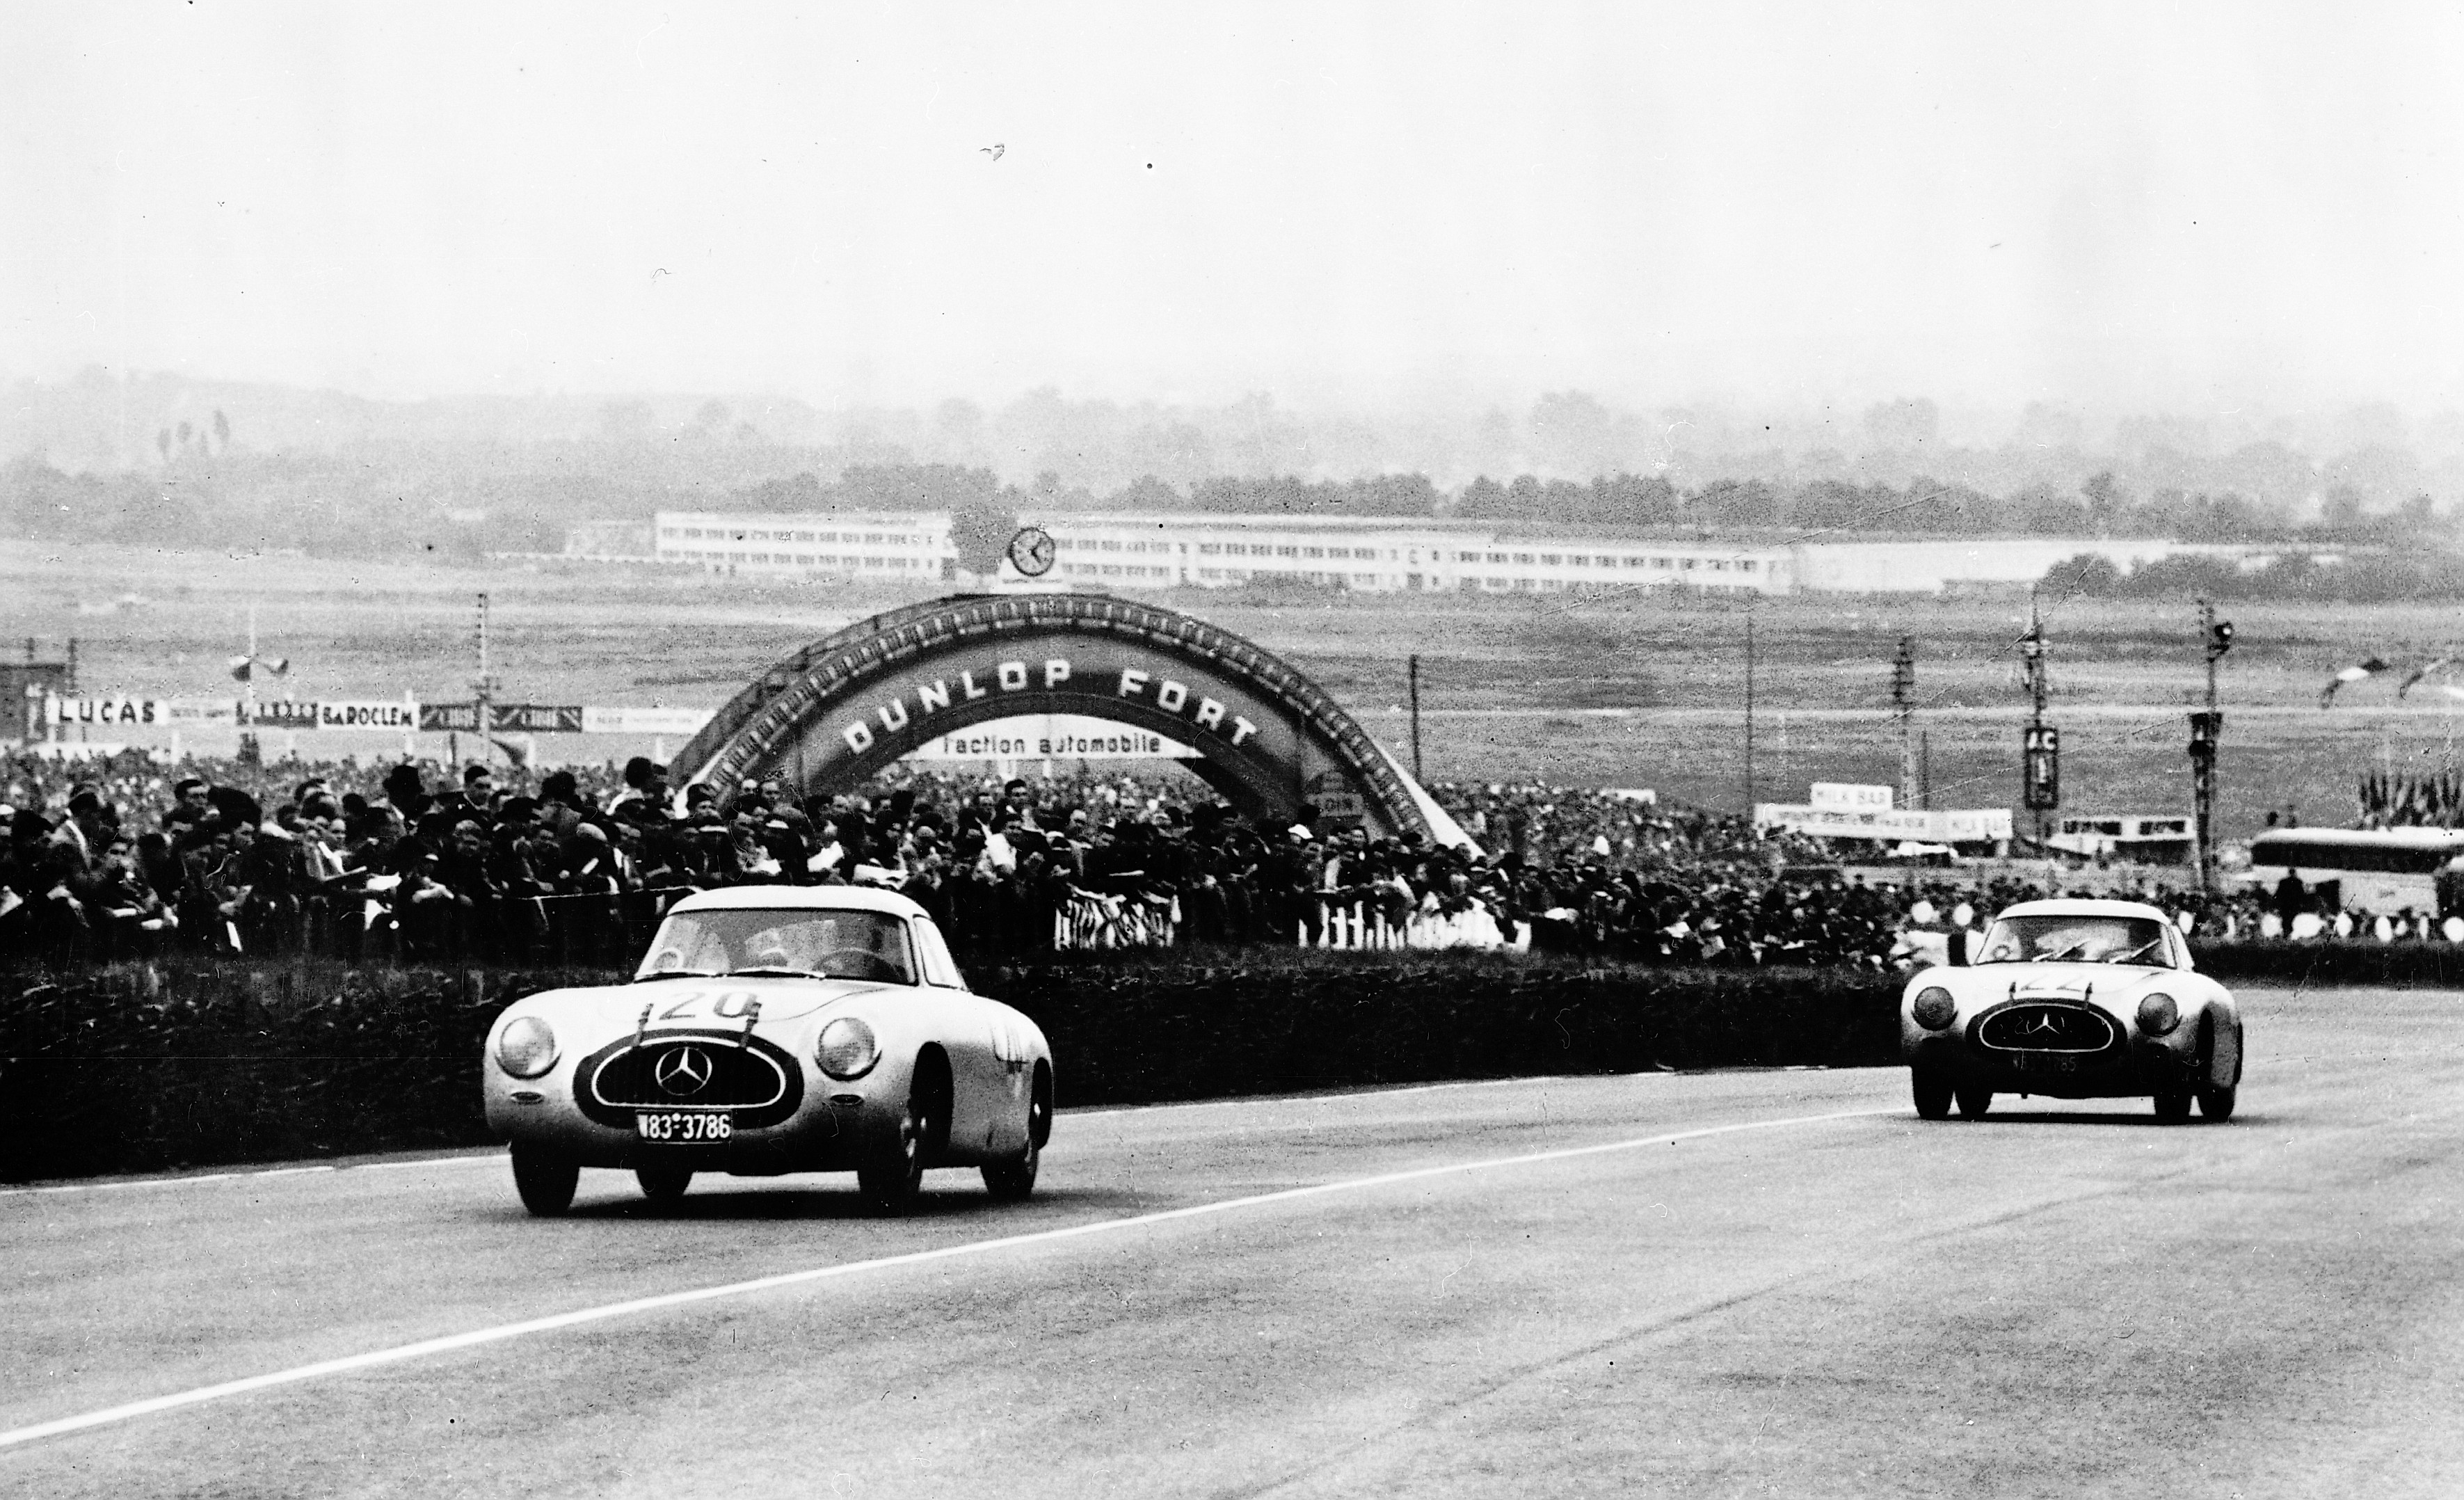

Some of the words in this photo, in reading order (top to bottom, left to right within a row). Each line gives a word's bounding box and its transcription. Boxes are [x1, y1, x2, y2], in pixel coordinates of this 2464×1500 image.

[58, 700, 156, 724] LUCAS
[842, 658, 1071, 753] DUNLOP
[1120, 669, 1256, 746] FORT
[1039, 733, 1160, 753] automobile
[658, 991, 758, 1021] 20
